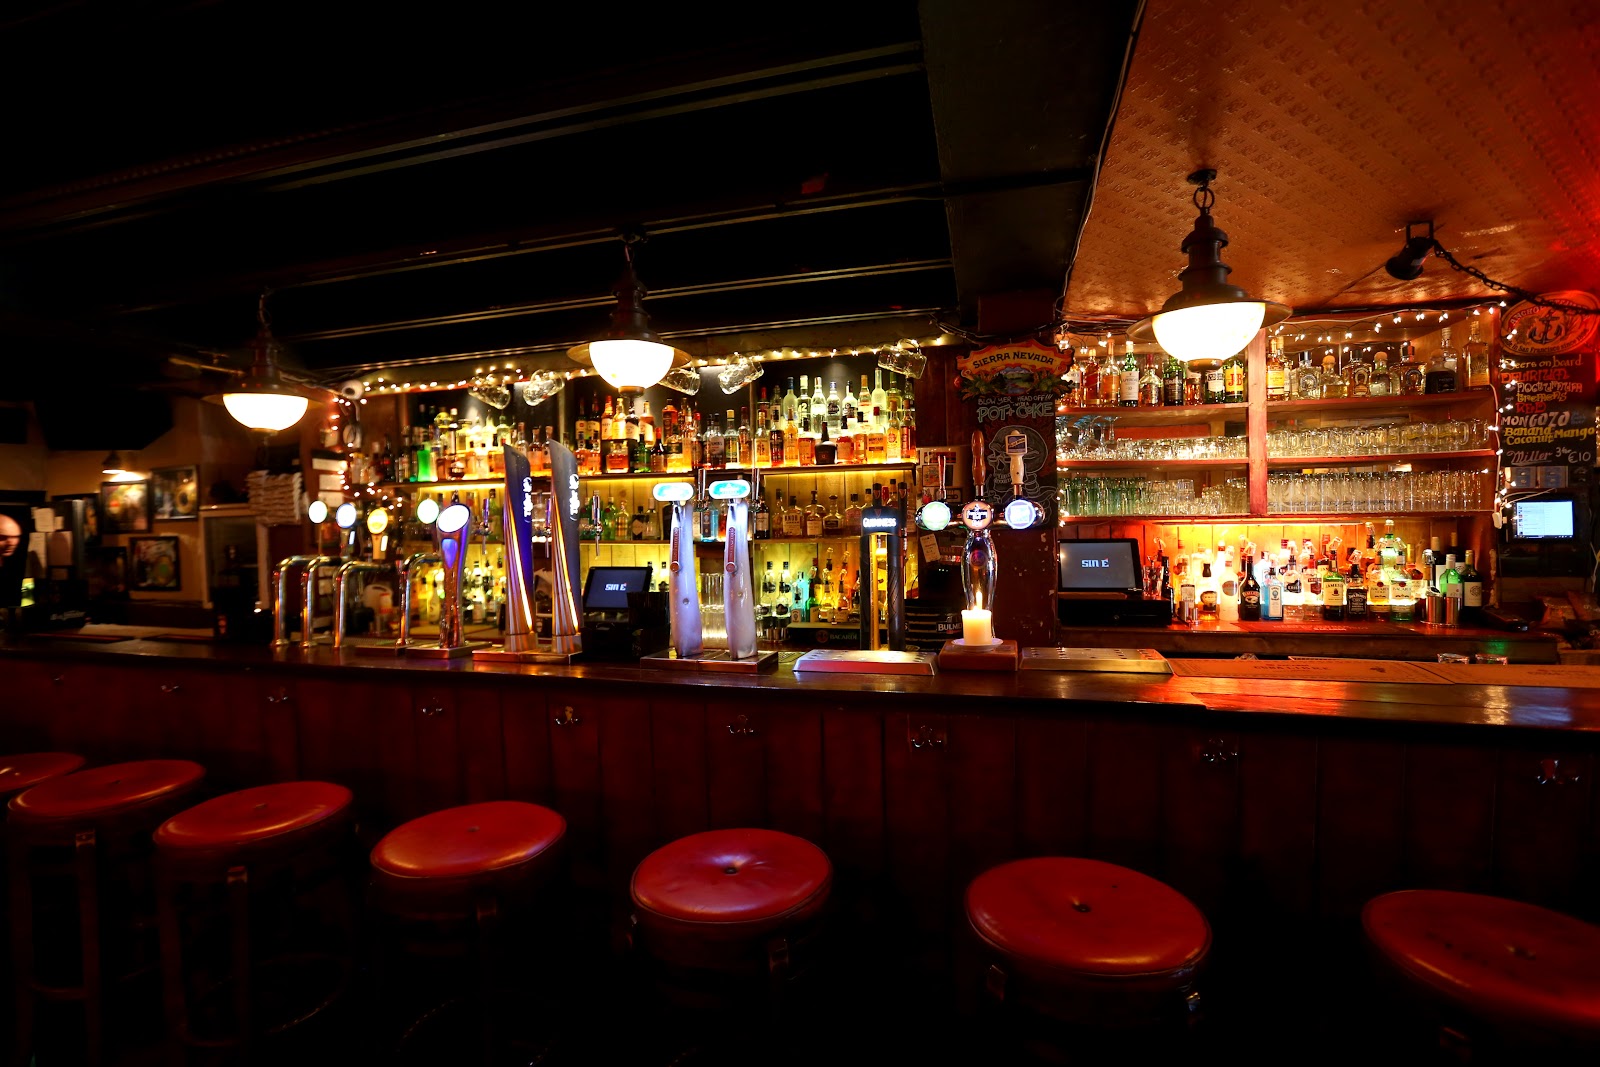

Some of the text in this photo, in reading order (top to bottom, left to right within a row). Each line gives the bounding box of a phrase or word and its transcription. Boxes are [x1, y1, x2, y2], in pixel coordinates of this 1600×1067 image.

[972, 351, 1055, 369] SIERRA NEVADA
[1538, 360, 1552, 368] on
[1552, 353, 1582, 369] board
[1515, 401, 1547, 415] RED
[1500, 410, 1571, 429] MONGOZO
[1504, 426, 1595, 440] Banana Mango
[1506, 433, 1554, 446] Coconut
[1506, 450, 1553, 466] Miller
[1567, 451, 1591, 464] €10
[1081, 559, 1100, 568] SIN
[605, 583, 619, 591] SIN
